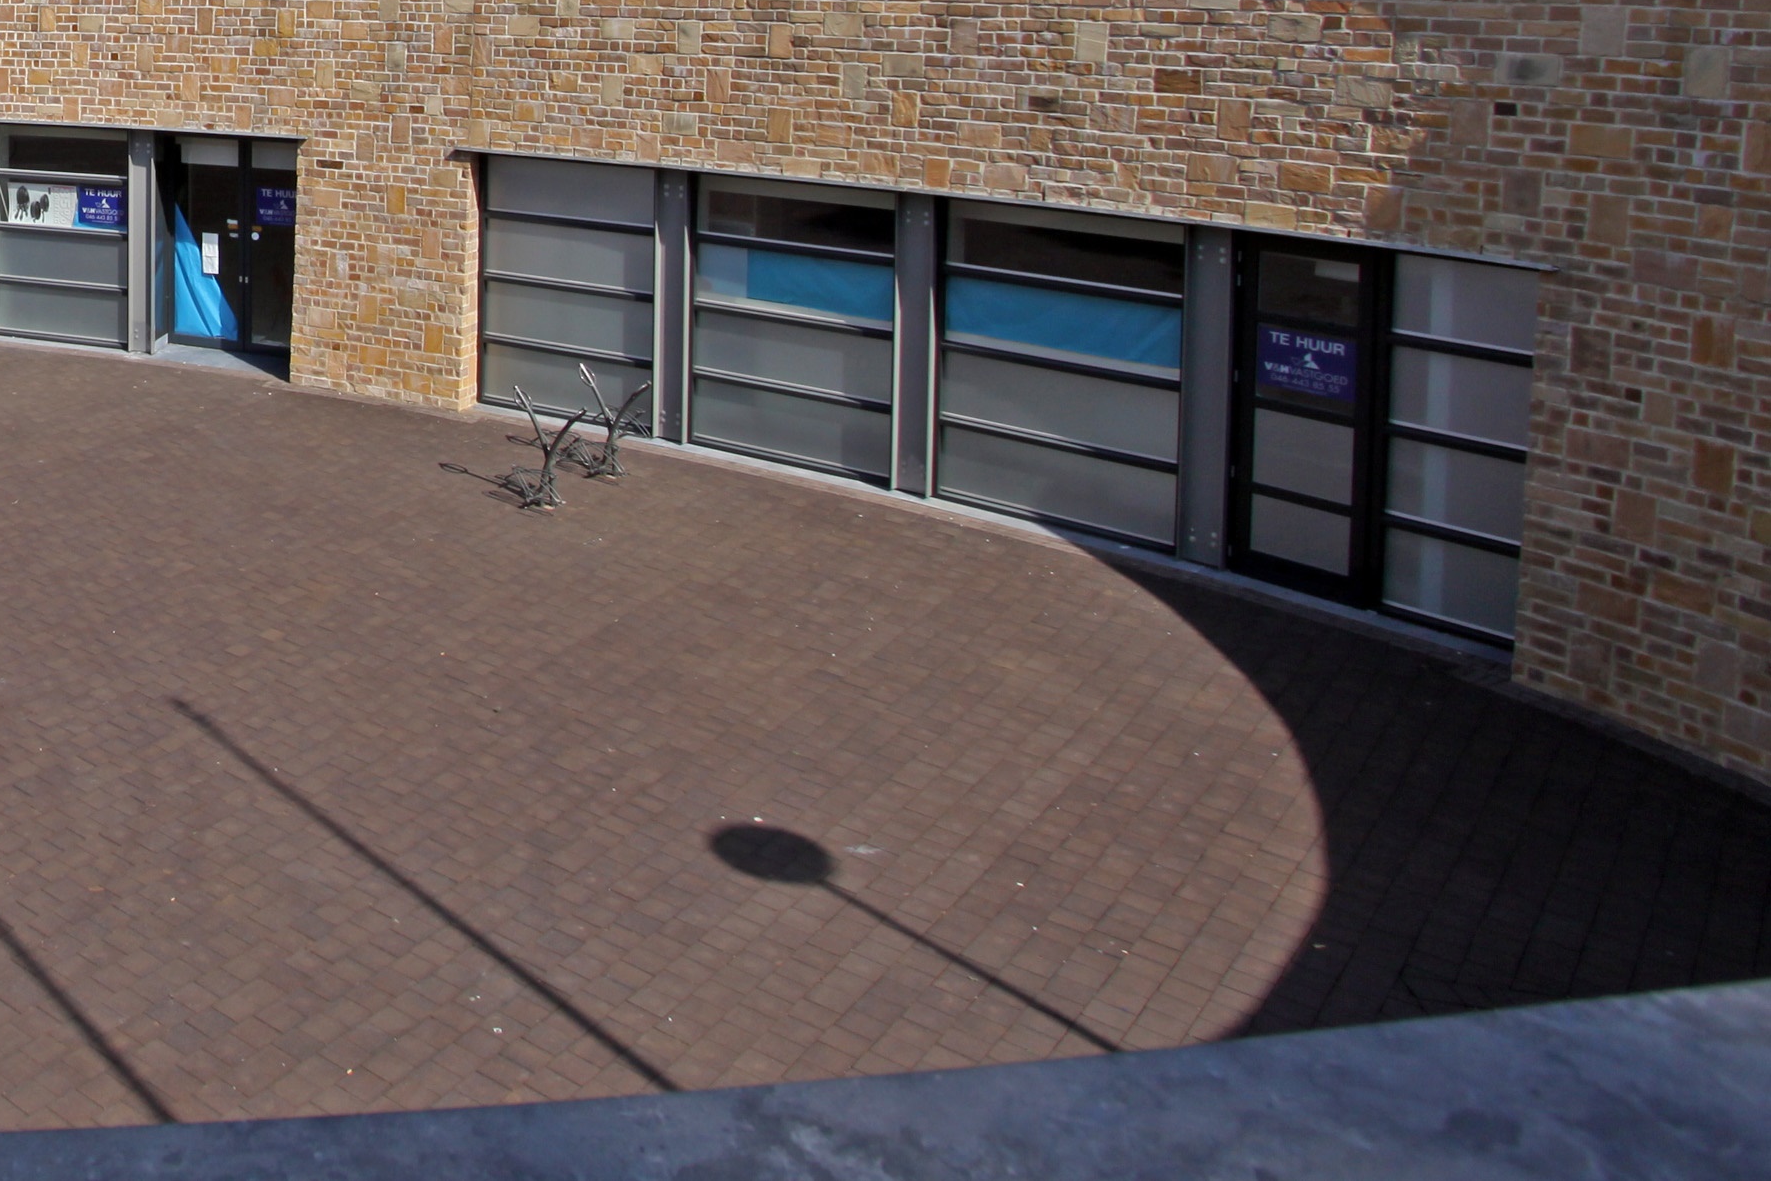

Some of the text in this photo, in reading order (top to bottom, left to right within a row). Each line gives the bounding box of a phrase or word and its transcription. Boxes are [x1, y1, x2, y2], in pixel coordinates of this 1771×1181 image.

[84, 188, 122, 198] TE HUUR
[261, 188, 272, 197] TE
[1269, 331, 1345, 356] TE HUUR
